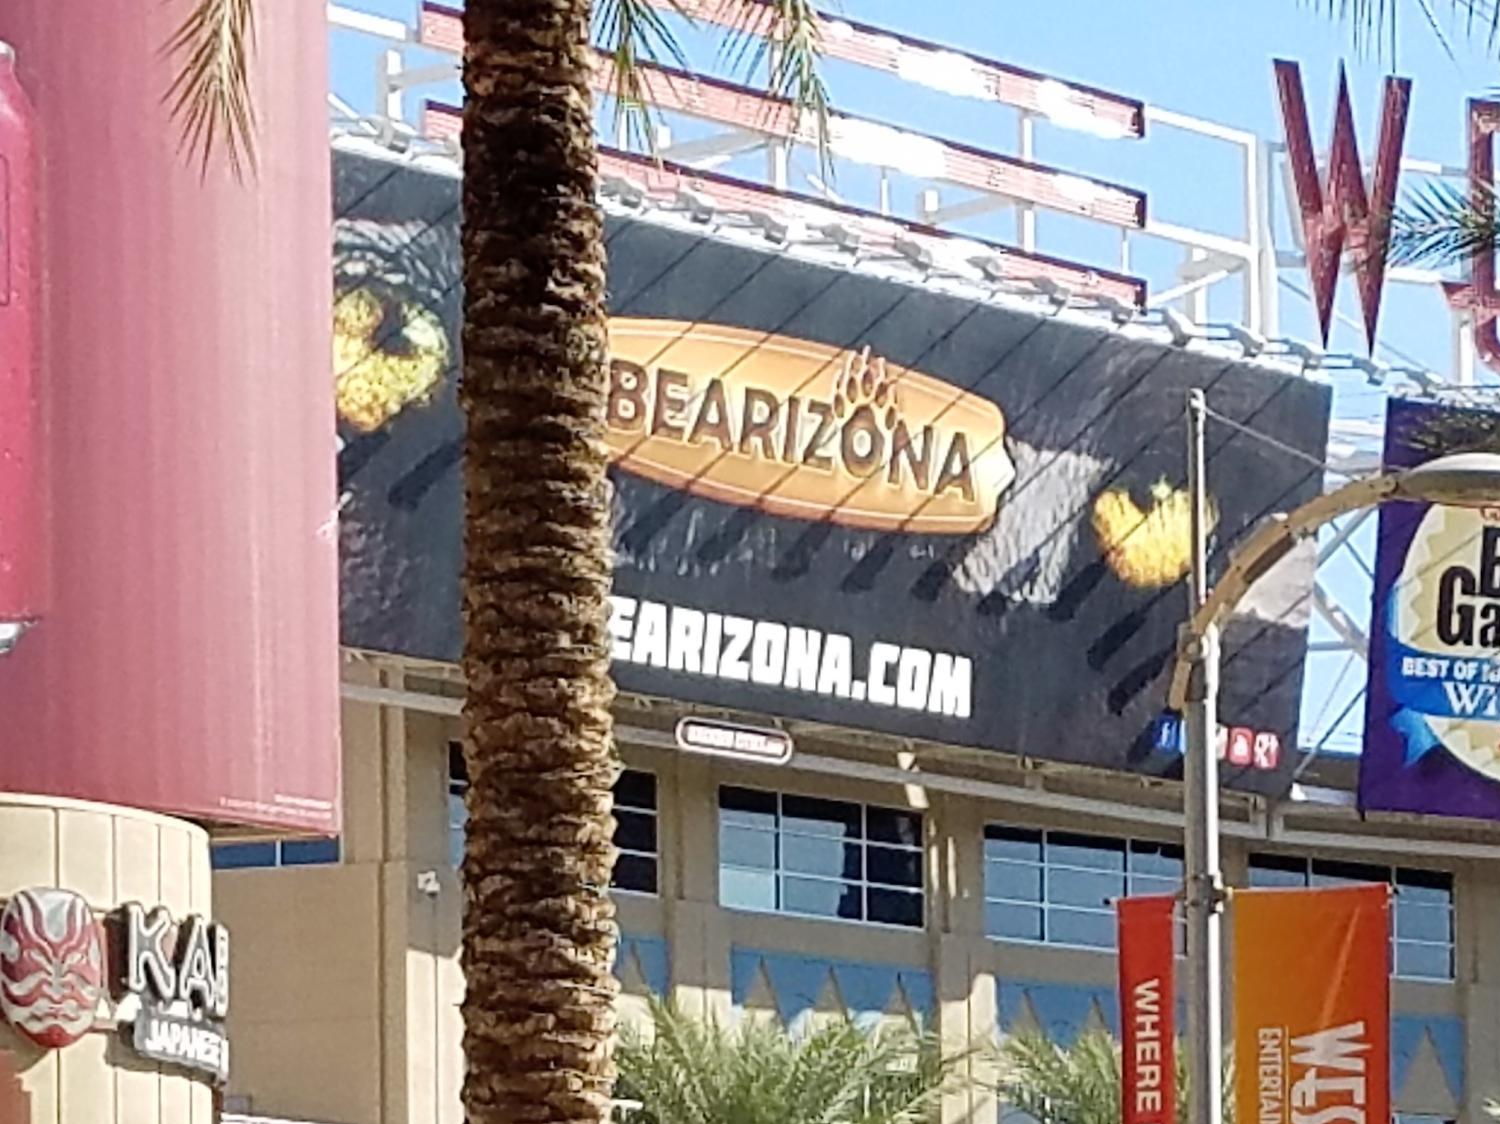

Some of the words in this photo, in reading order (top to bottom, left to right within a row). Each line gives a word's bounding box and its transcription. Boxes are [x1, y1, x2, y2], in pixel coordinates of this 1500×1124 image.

[604, 357, 976, 503] BEARIZONA
[606, 596, 973, 719] EARIZONA.COM
[1402, 656, 1450, 680] BEST
[1453, 659, 1480, 682] OF
[1134, 979, 1162, 1113] WHERE
